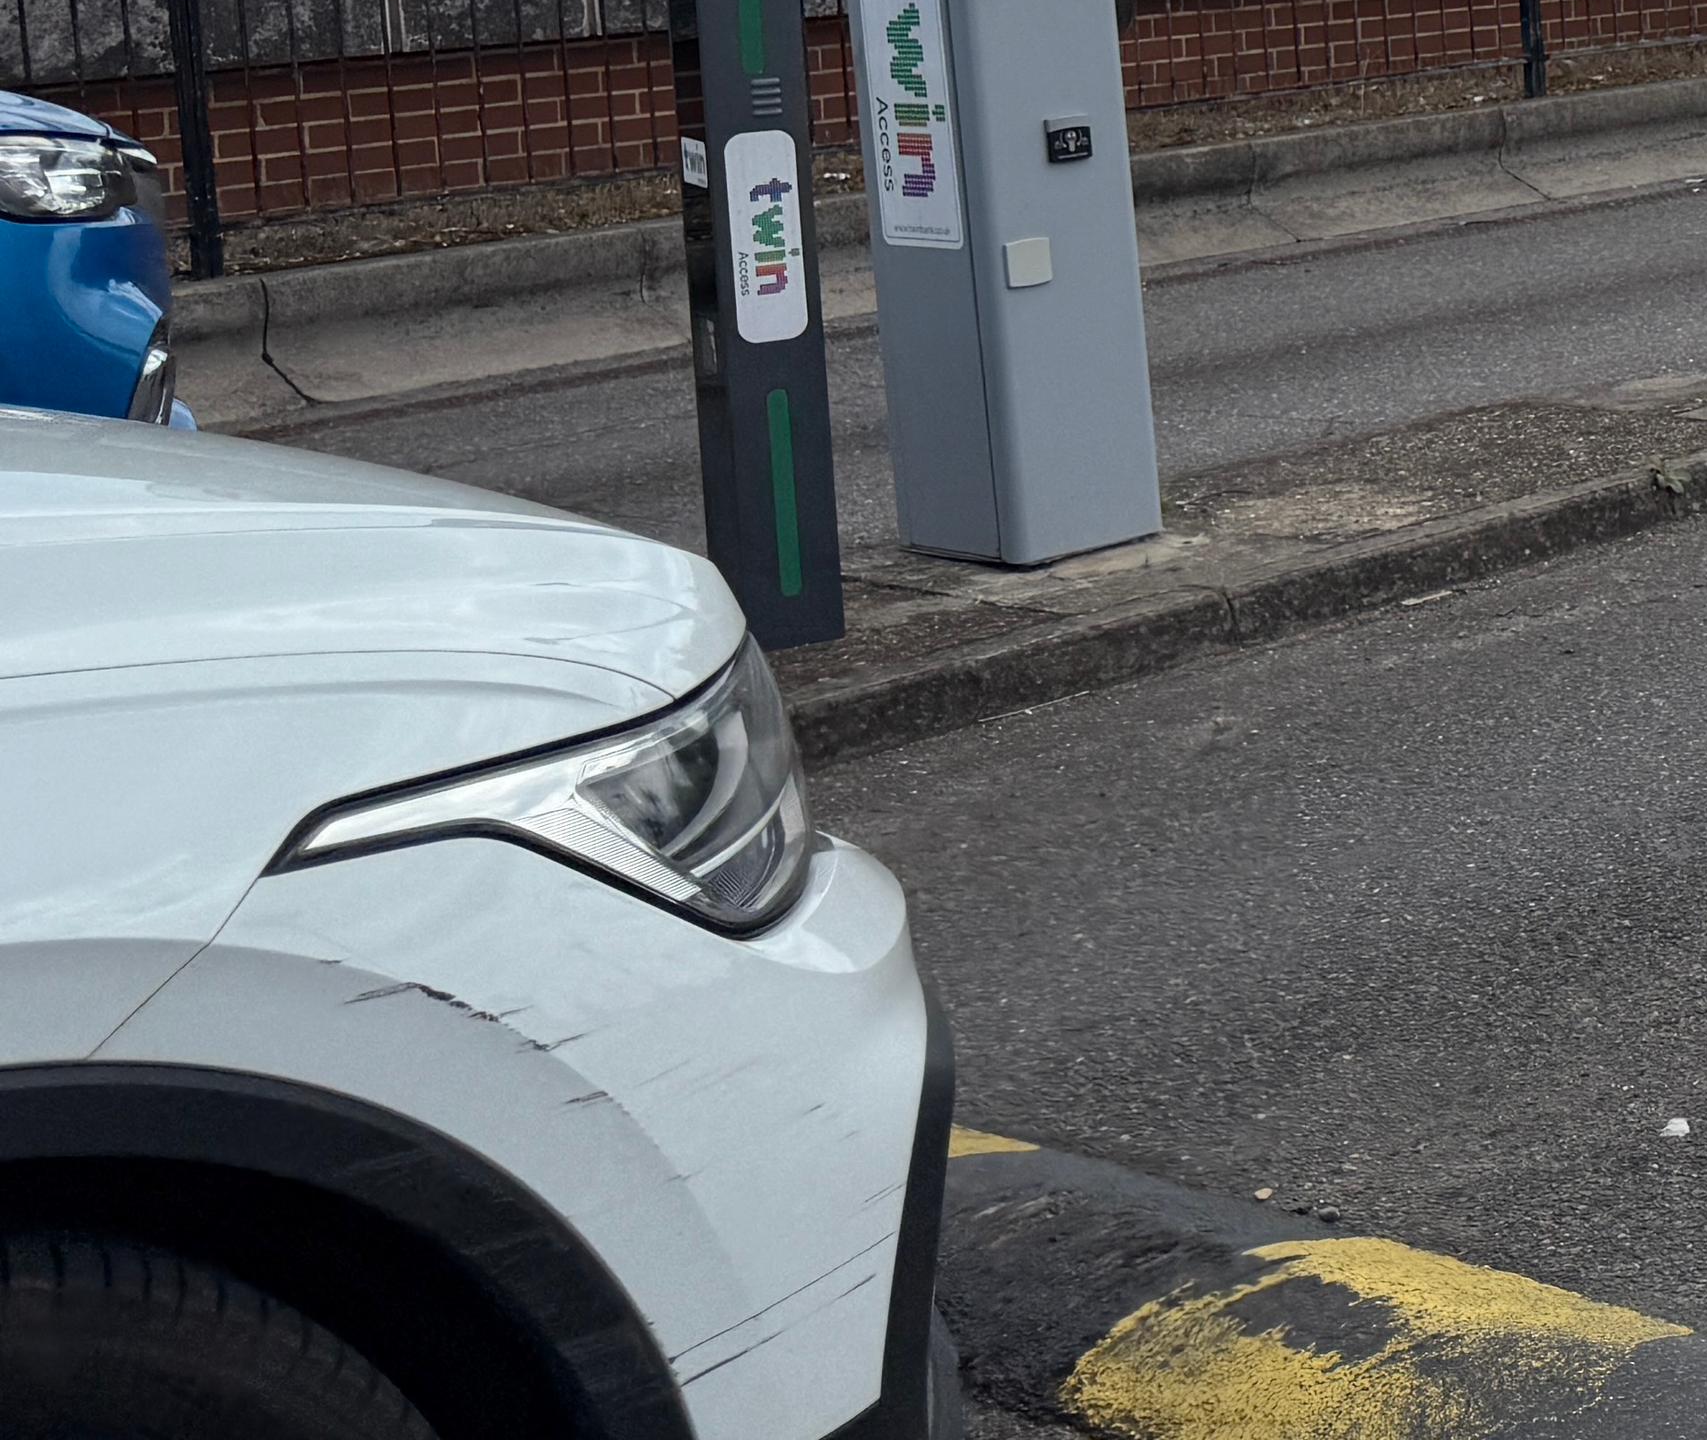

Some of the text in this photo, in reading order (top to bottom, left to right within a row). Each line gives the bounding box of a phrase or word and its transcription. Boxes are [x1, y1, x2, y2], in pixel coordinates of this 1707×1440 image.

[875, 96, 894, 192] Access
[738, 251, 750, 296] Access
[750, 178, 800, 296] twin
